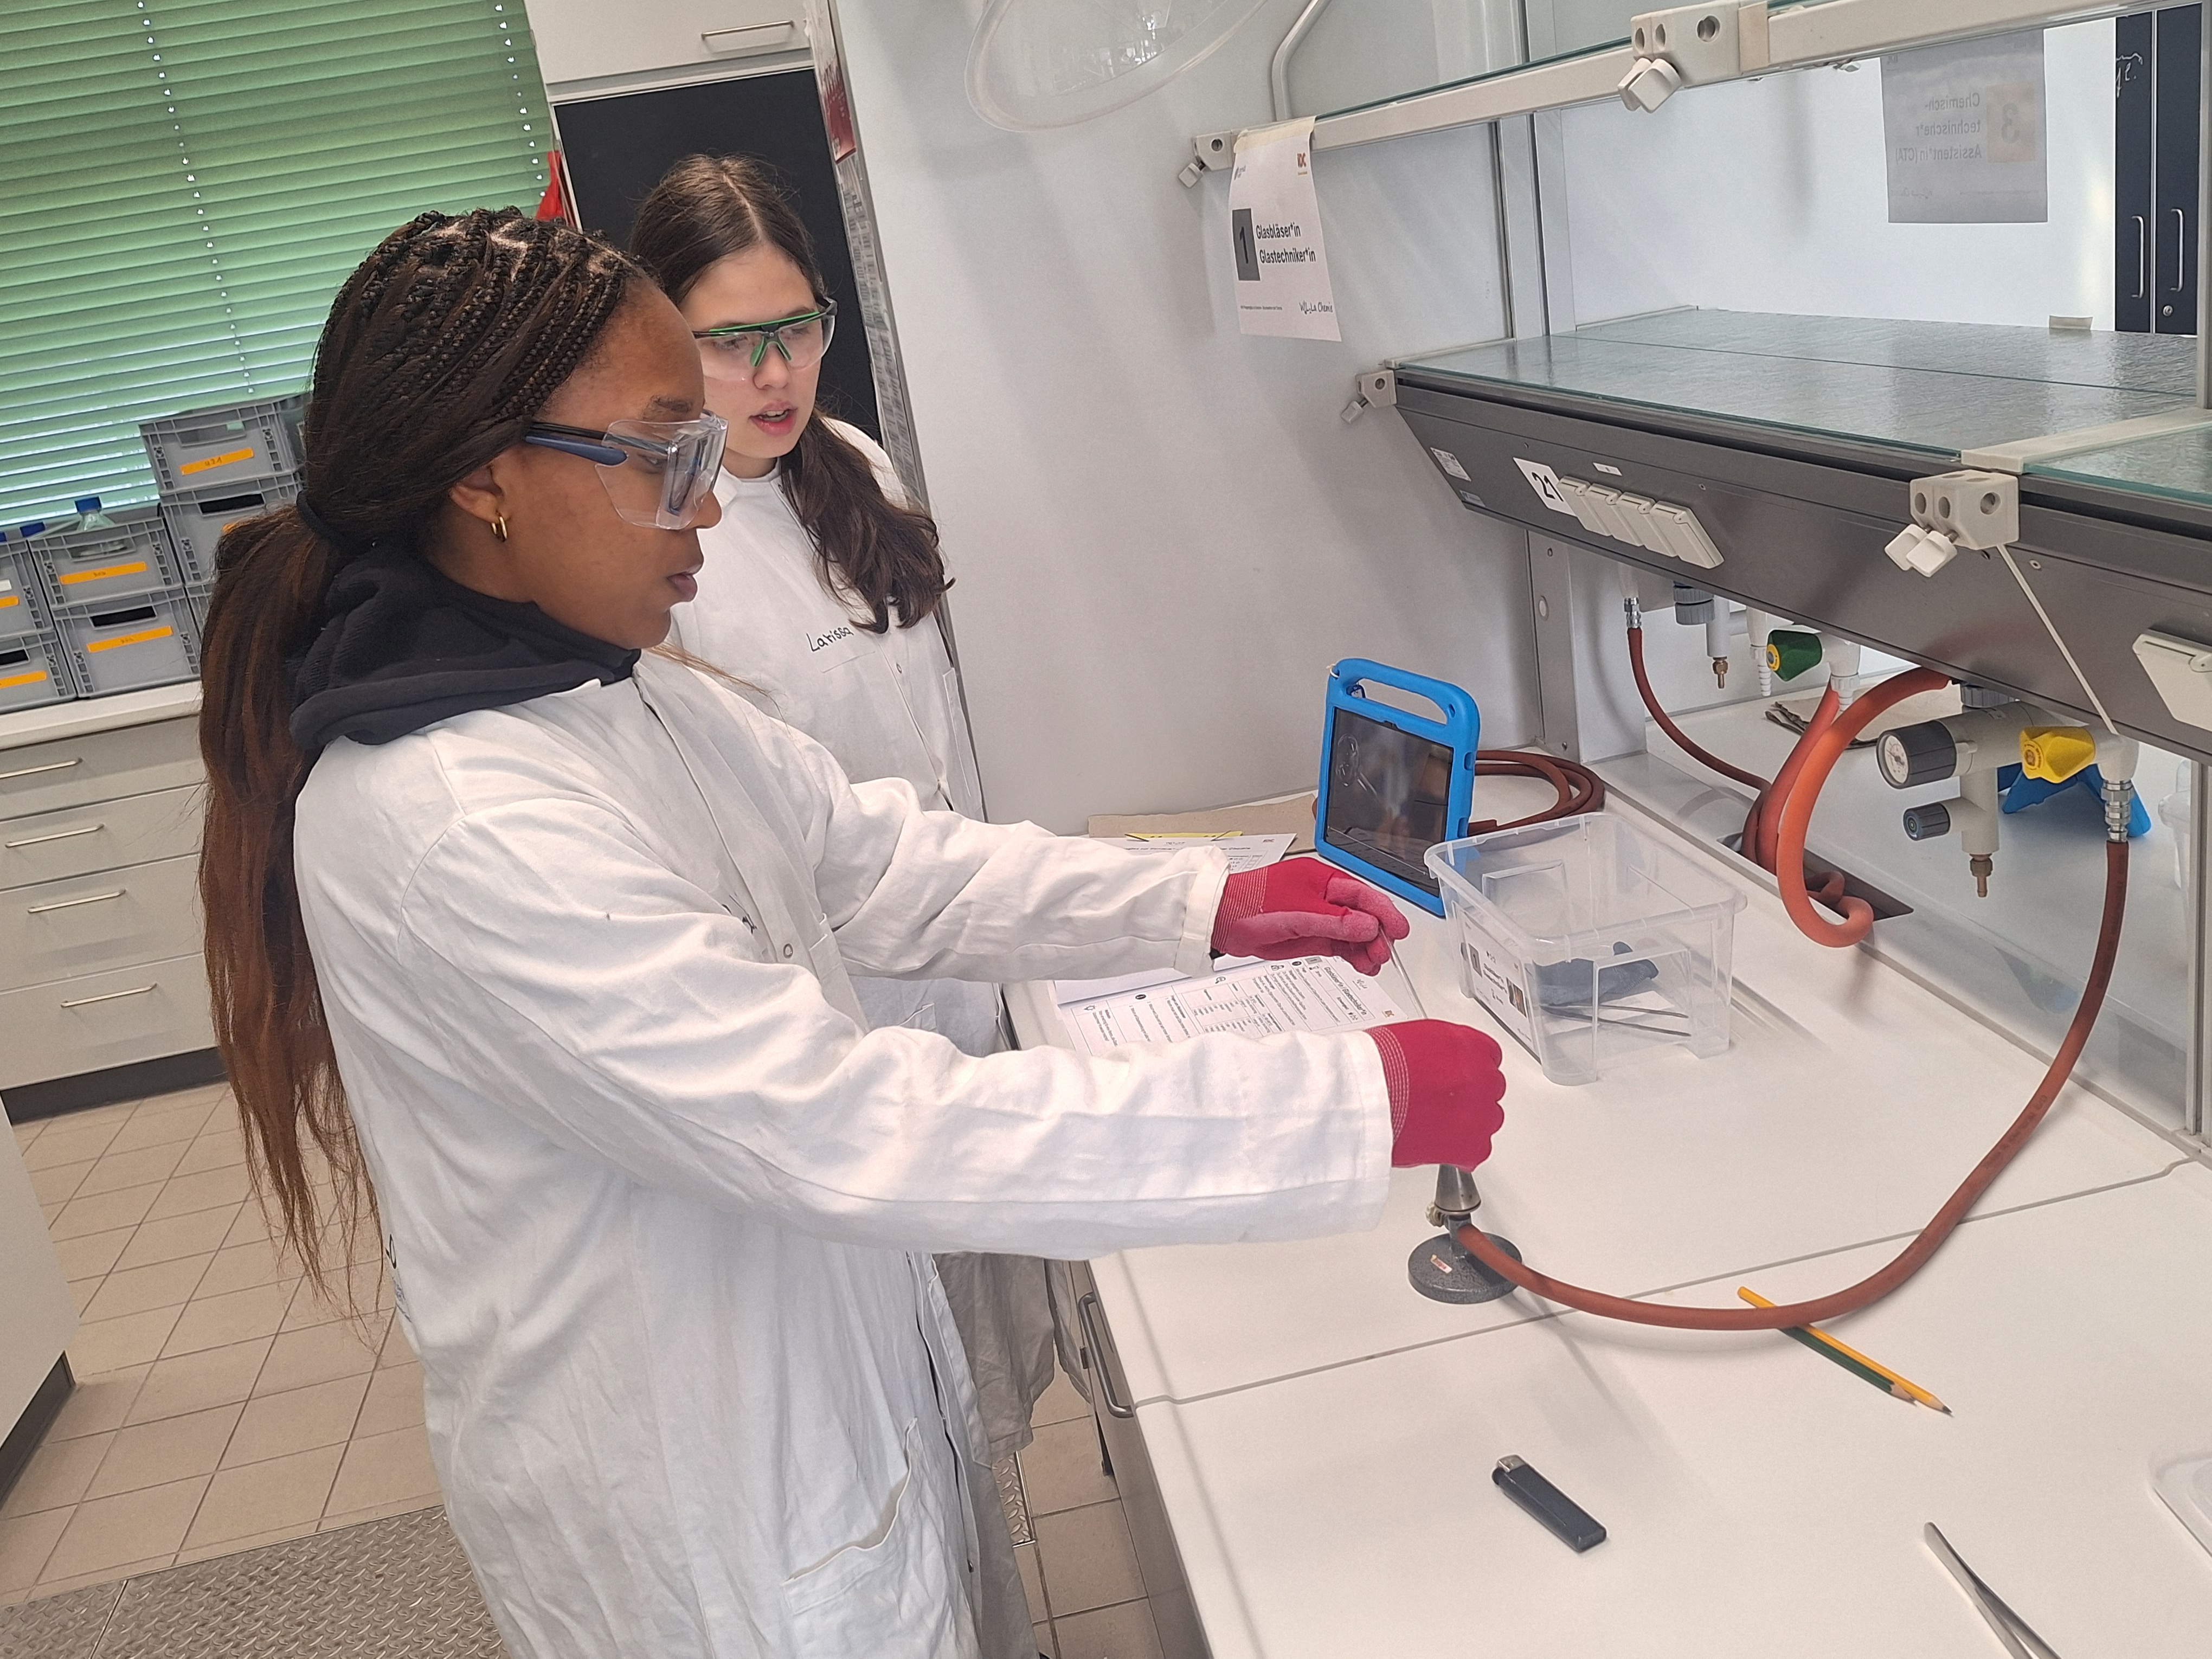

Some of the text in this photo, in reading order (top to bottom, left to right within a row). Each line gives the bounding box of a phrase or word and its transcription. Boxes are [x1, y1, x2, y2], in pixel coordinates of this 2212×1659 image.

[1239, 226, 1249, 264] 1
[1531, 471, 1564, 502] 21
[806, 627, 854, 652] Larissa
